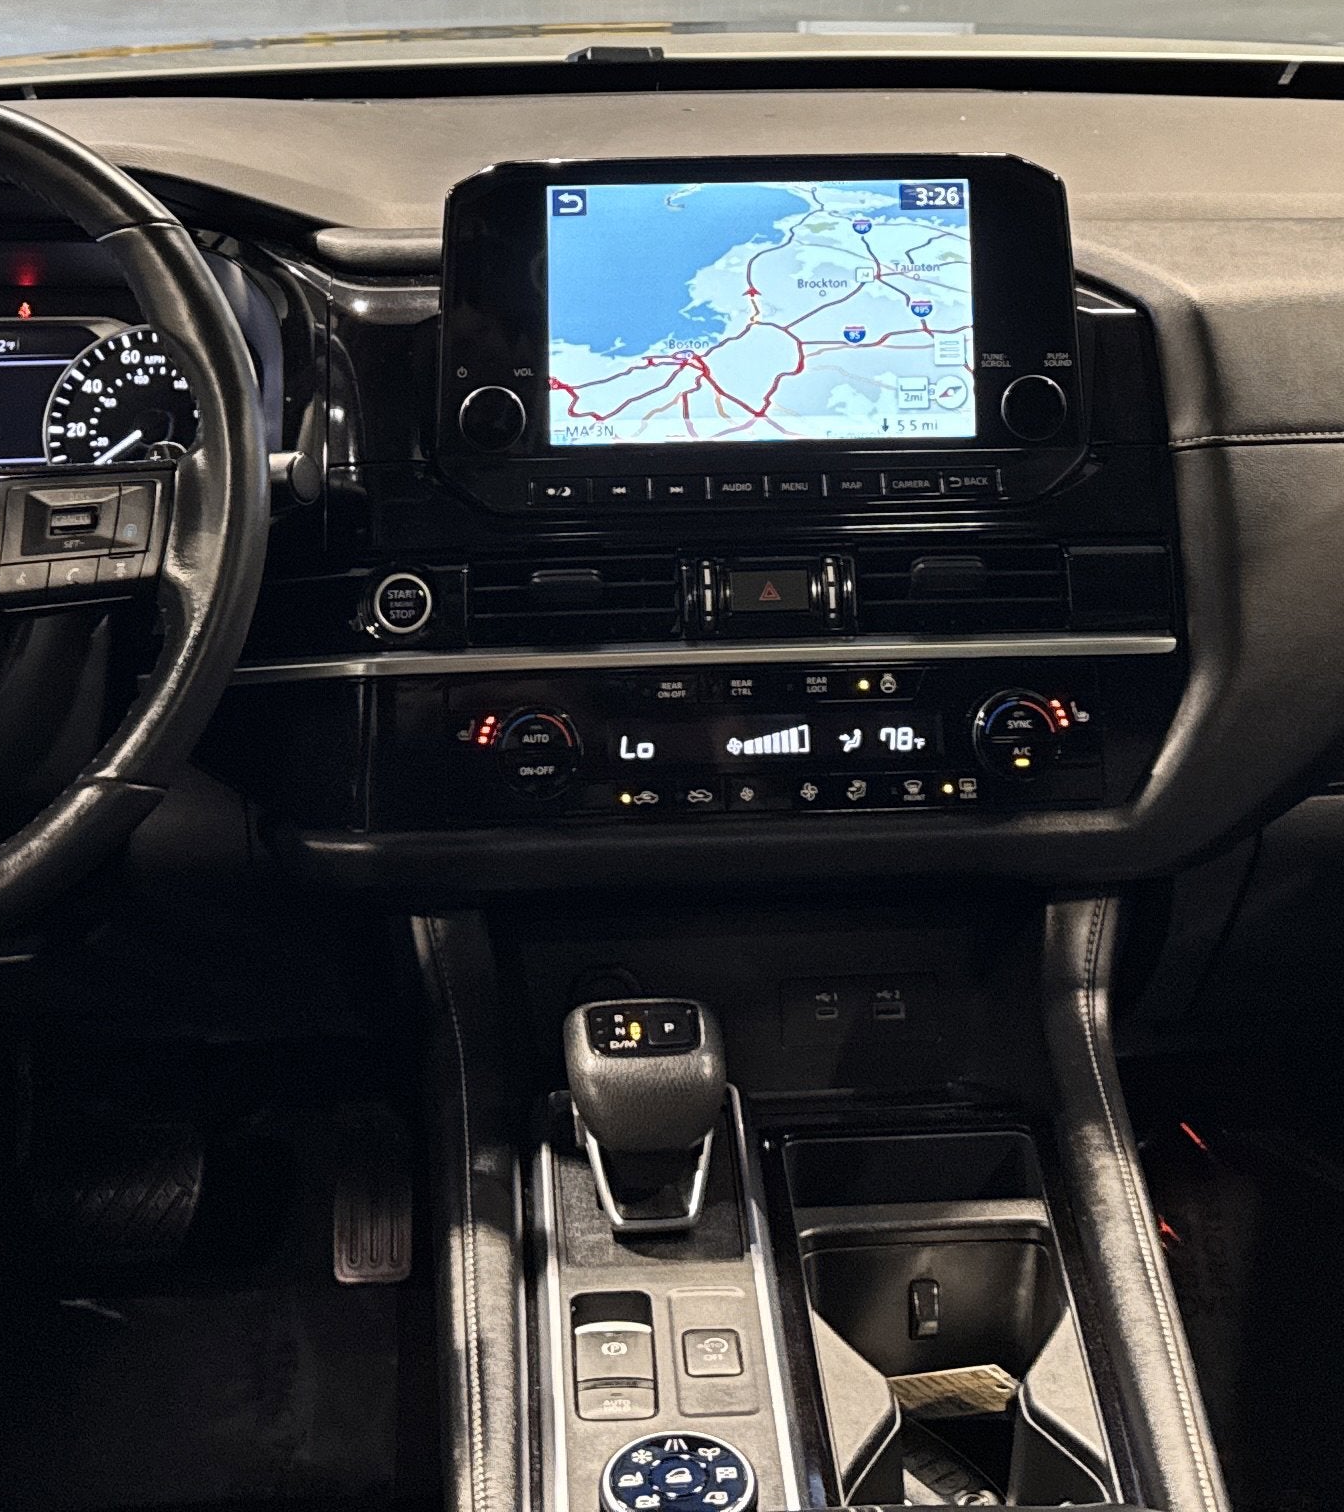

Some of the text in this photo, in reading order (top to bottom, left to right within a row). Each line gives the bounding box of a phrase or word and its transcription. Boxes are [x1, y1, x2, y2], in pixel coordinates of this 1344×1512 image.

[916, 187, 960, 206] 3:26
[894, 262, 941, 272] Taunton
[797, 278, 848, 289] Brockton
[668, 339, 710, 350] Boston
[120, 349, 141, 365] 60
[1047, 352, 1069, 360] PUSH
[981, 360, 1011, 368] SCROLL
[1043, 359, 1072, 367] SOUND
[513, 367, 534, 377] VOL
[81, 378, 103, 394] 40
[921, 419, 938, 430] mi
[66, 422, 87, 438] 20
[841, 481, 863, 489] MAP
[892, 479, 931, 489] CAMERA
[964, 476, 988, 486] BACK
[722, 482, 752, 492] AUDIO
[781, 482, 809, 491] MENU
[387, 589, 417, 599] START
[389, 609, 415, 619] STOP
[661, 681, 683, 689] REAR
[730, 679, 752, 687] REAR
[806, 676, 827, 685] REAR
[731, 688, 752, 696] CTRL
[807, 685, 828, 693] LOCK
[1007, 719, 1033, 729] SYNC
[522, 734, 550, 743] AUTO
[620, 735, 655, 759] Lo
[1013, 746, 1031, 755] A/C
[615, 1026, 626, 1036] N
[663, 1022, 675, 1033] P
[609, 1039, 637, 1050] D/M
